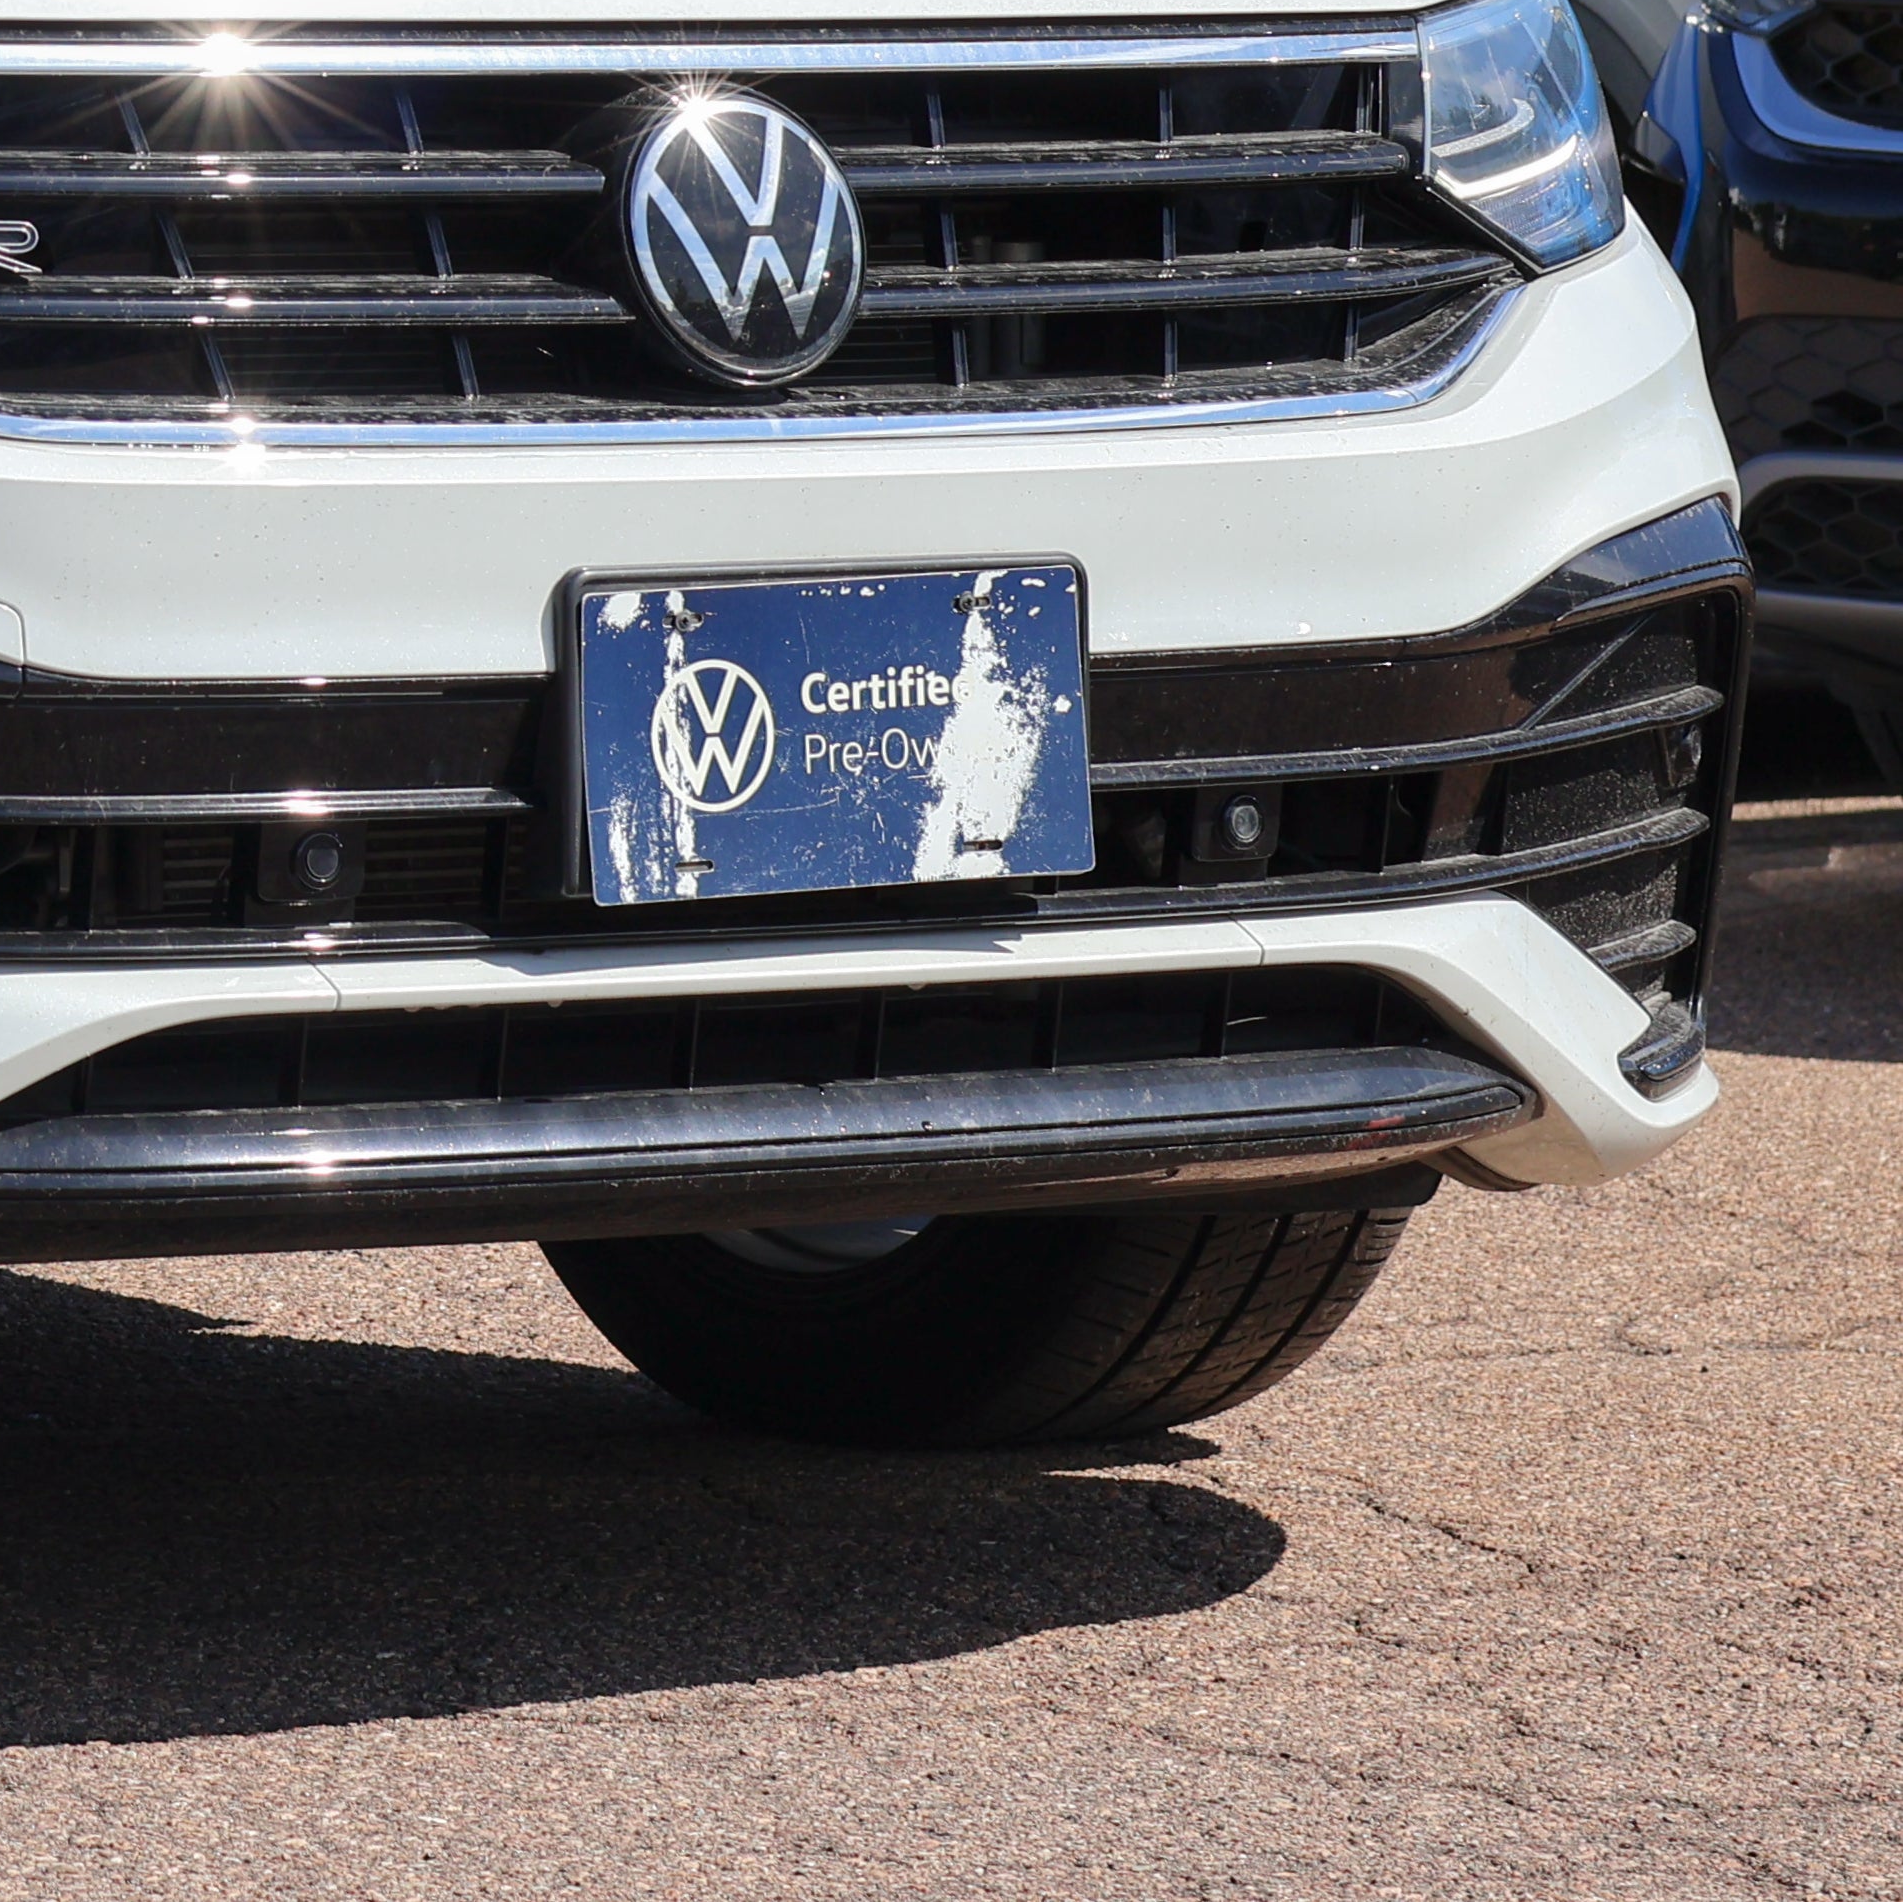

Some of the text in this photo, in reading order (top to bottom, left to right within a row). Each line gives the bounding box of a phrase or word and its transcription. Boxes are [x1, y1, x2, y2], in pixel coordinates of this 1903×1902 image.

[631, 96, 859, 374] VW
[651, 659, 775, 812] VW
[803, 727, 951, 776] Pre-Ow
